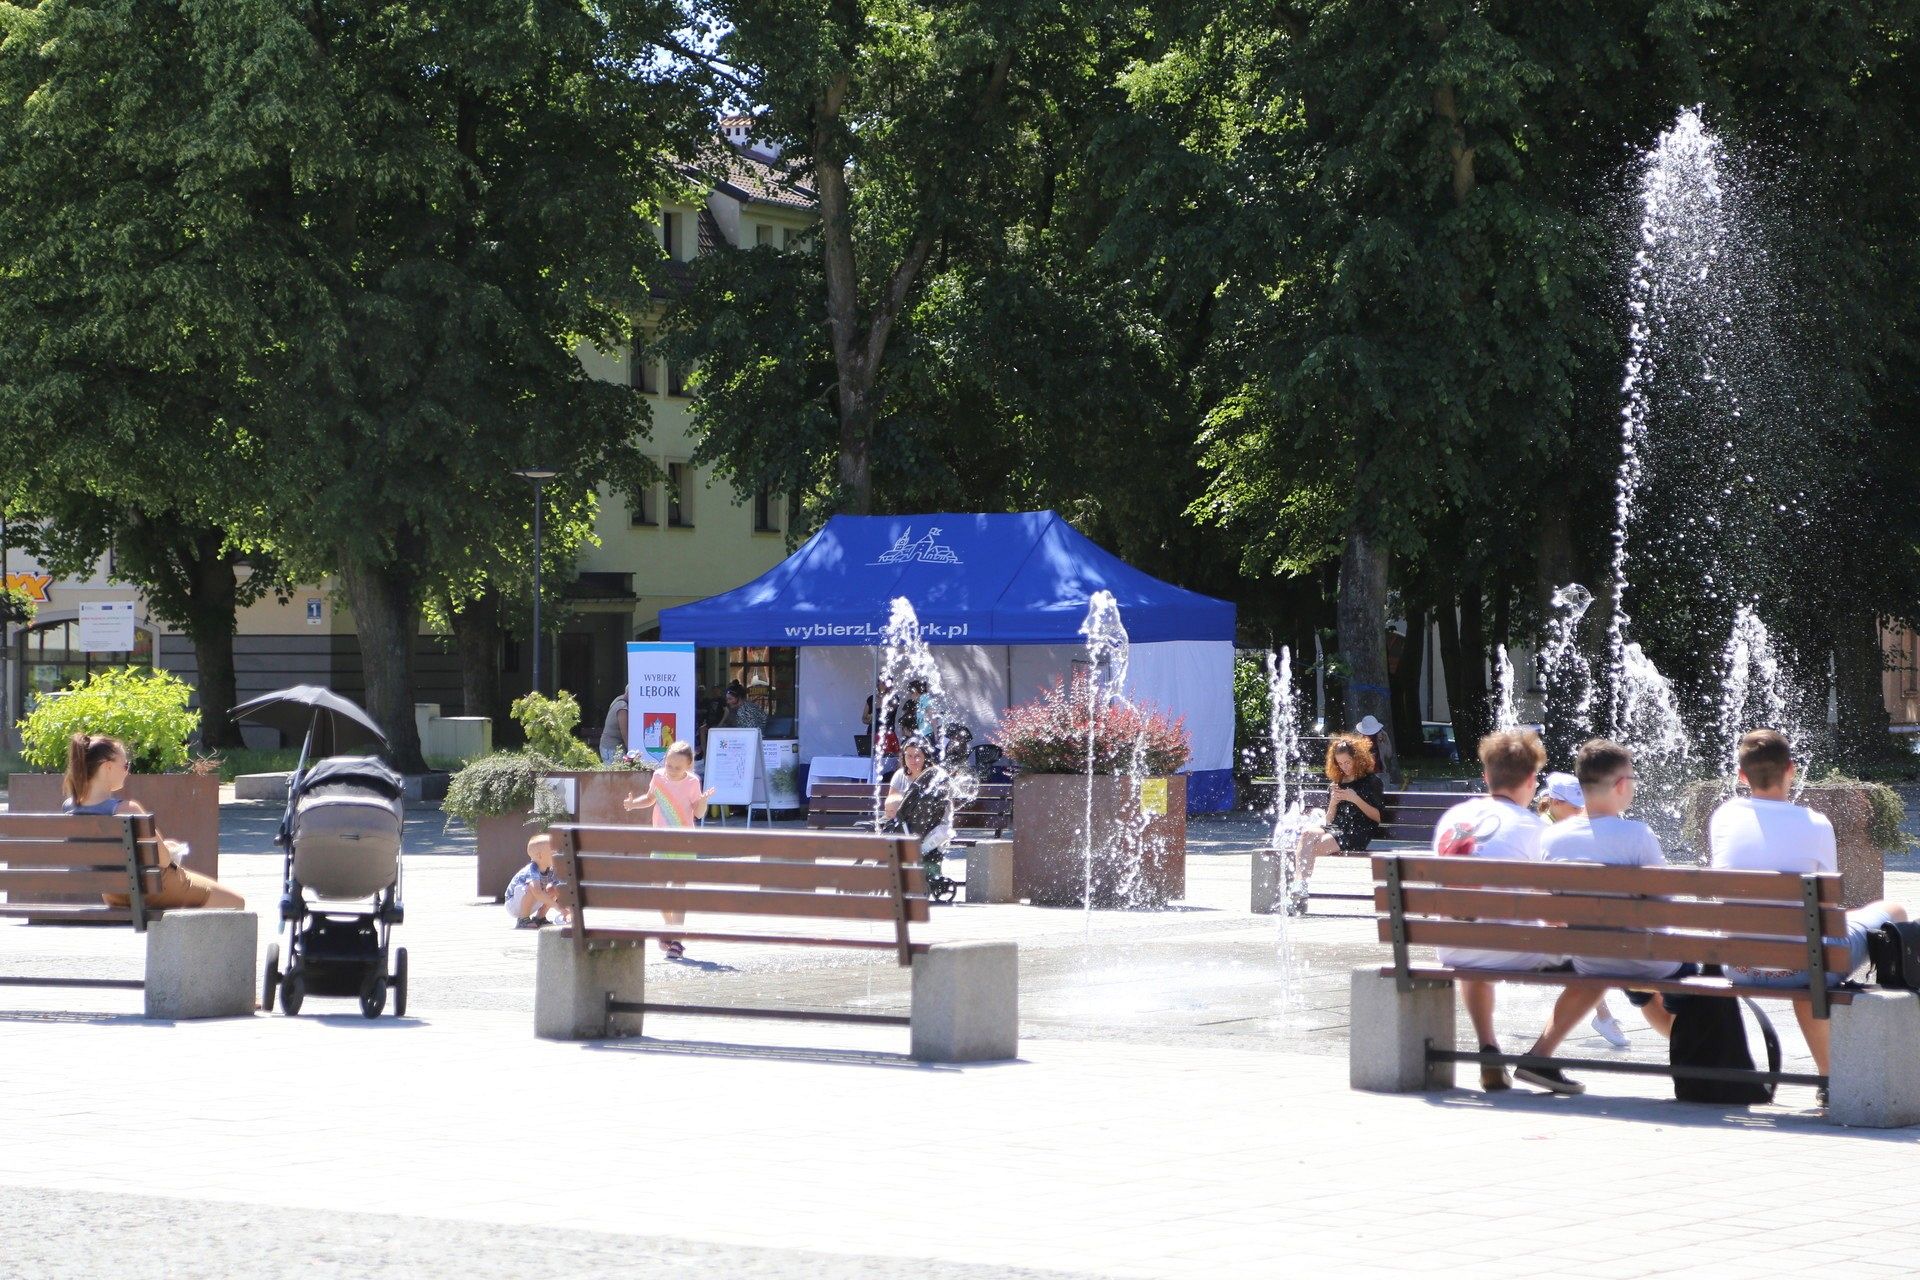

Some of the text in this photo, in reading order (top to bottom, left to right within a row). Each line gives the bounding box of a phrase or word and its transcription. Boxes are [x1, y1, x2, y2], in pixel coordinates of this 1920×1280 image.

[310, 604, 317, 616] 1
[785, 623, 968, 640] wybierzLerk.pl
[640, 685, 680, 698] LĘBORK
